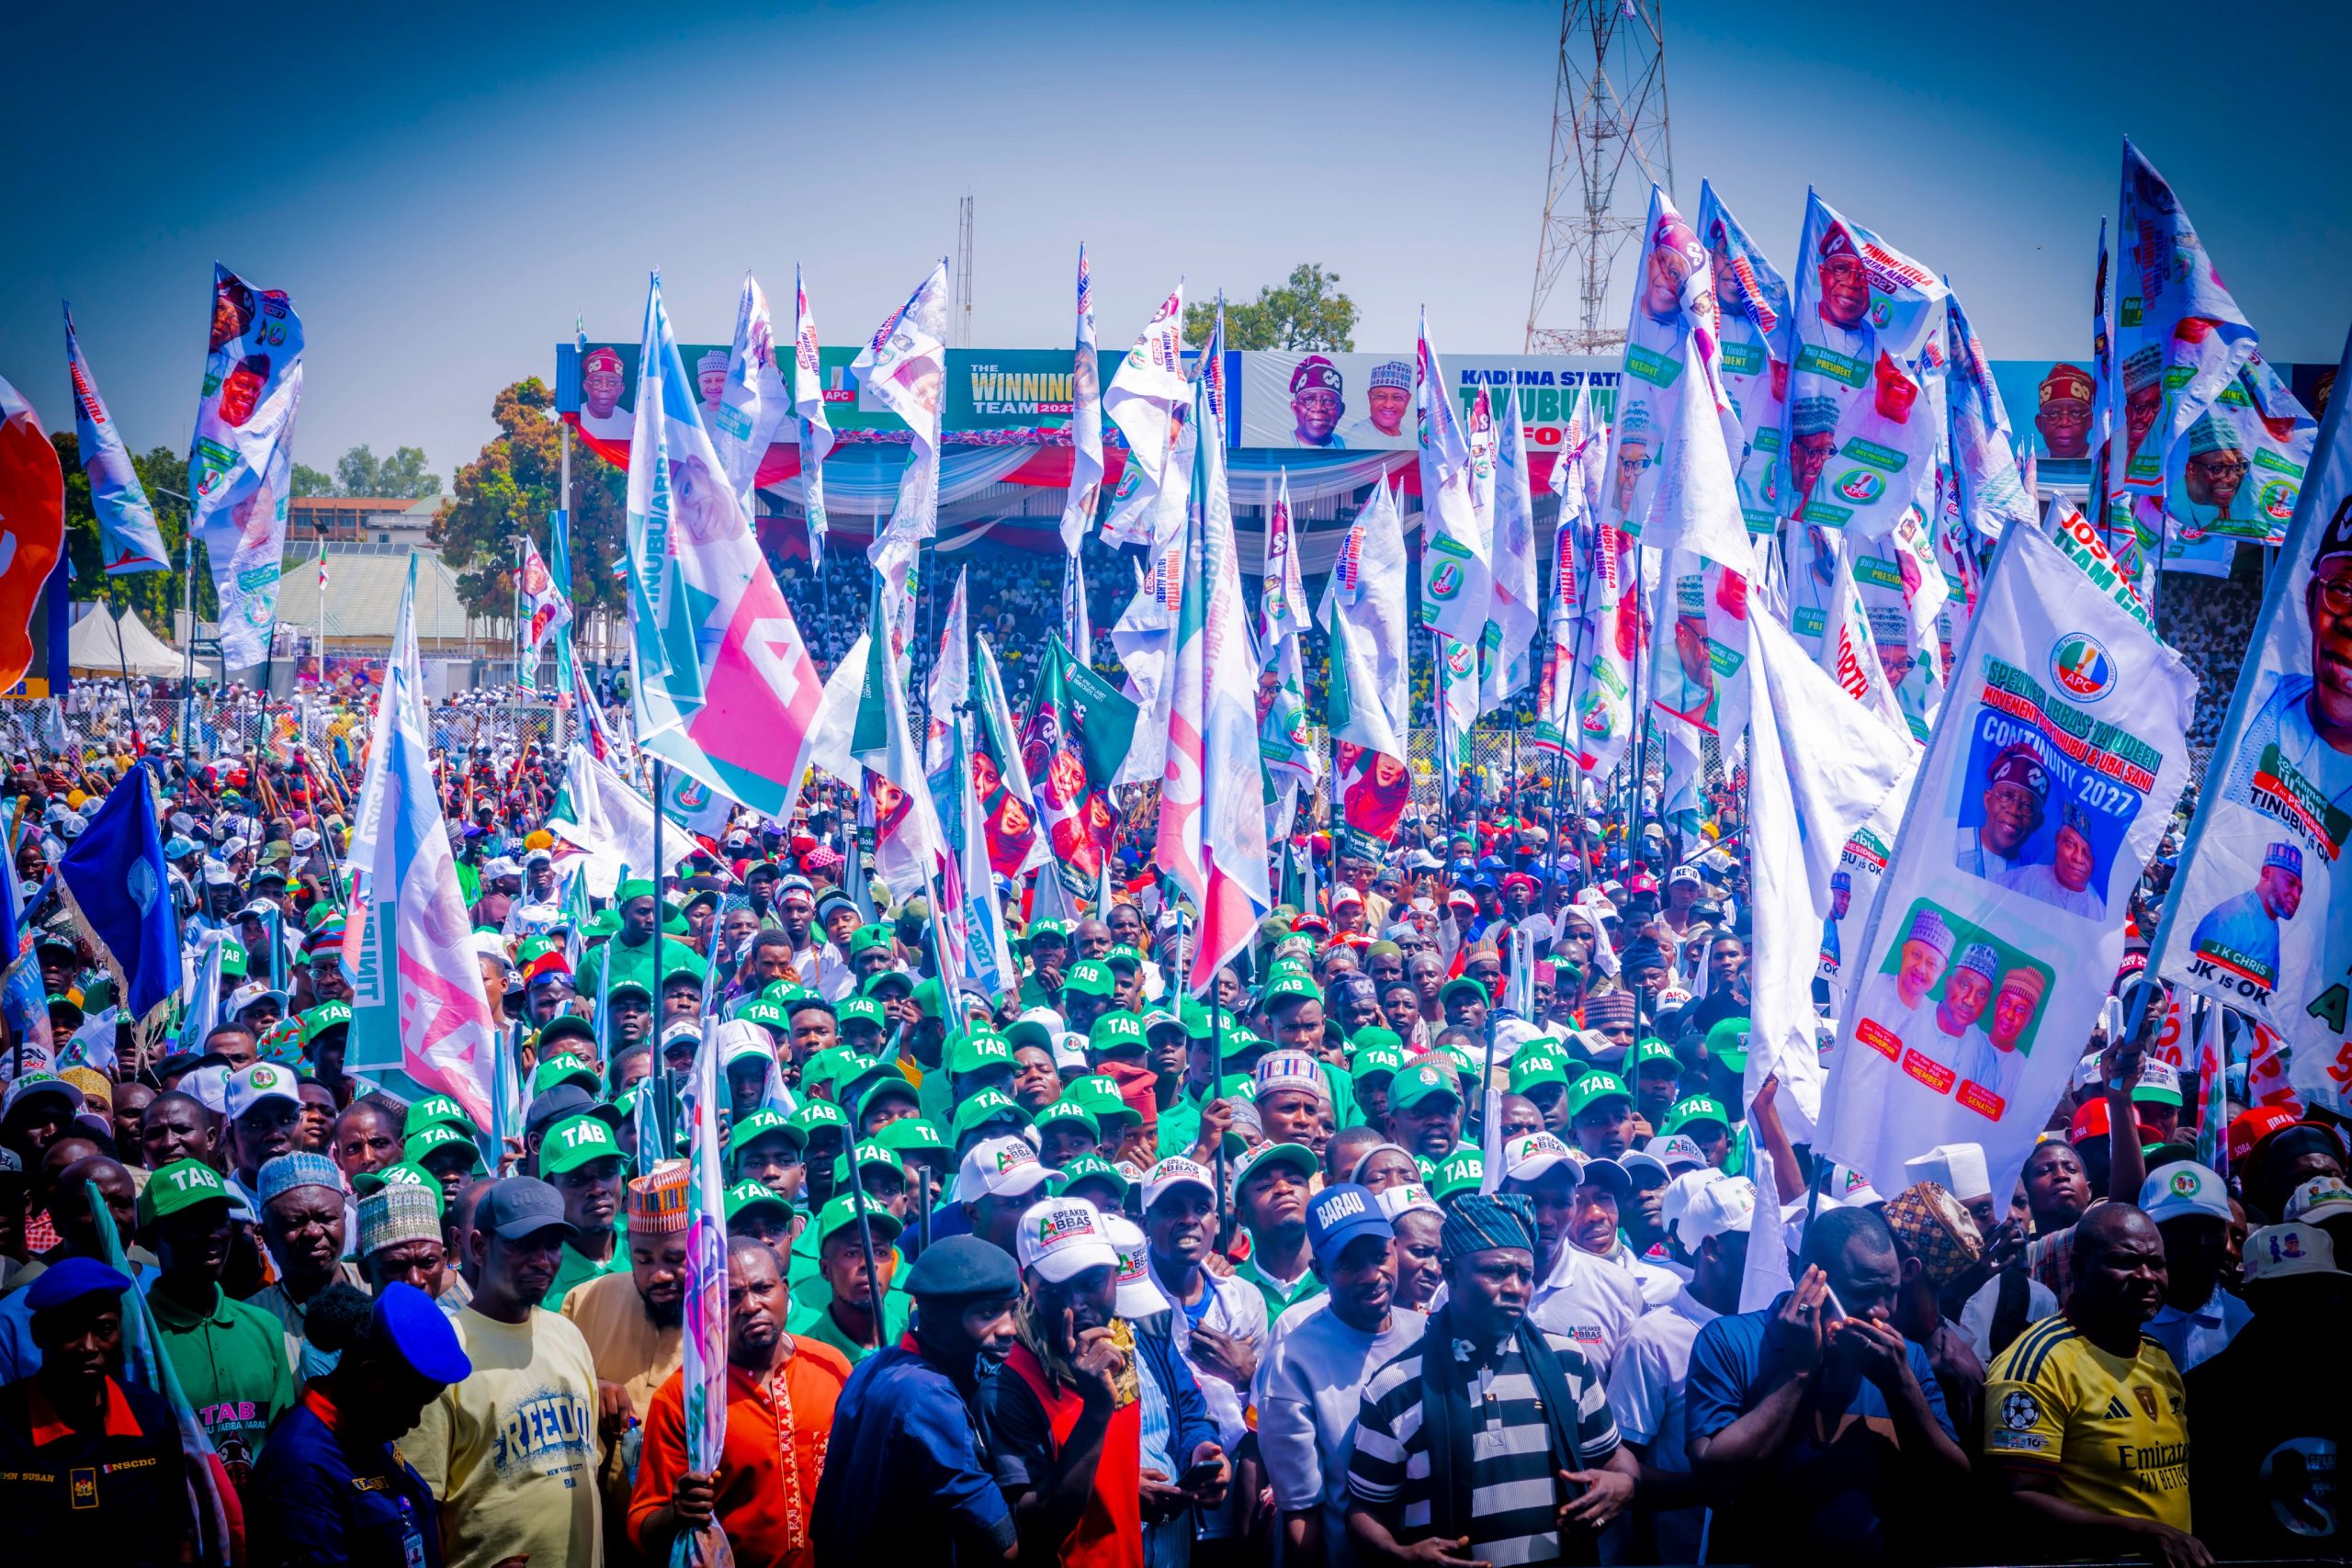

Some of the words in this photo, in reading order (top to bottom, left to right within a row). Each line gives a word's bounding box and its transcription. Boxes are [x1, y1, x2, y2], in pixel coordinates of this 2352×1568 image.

[1861, 243, 1901, 268] TINUBU
[1898, 265, 1934, 287] FITILA
[1861, 256, 1887, 273] FATAN
[1884, 269, 1916, 289] ALHERI
[1731, 256, 1761, 299] TINUBU
[1866, 271, 1895, 291] 2027
[264, 304, 285, 319] 2027
[797, 342, 808, 368] 2027
[1152, 338, 1163, 365] 2027
[1816, 359, 1851, 378] PRESIDENT
[825, 391, 849, 400] APC
[83, 393, 106, 425] FITILA
[973, 402, 1038, 413] TEAM
[1846, 488, 1864, 497] APC
[2270, 509, 2291, 517] APC
[1349, 526, 1364, 560] TINUBU
[2061, 512, 2108, 560] JOS
[1157, 558, 1166, 578] FATAN
[1168, 549, 1180, 581] TINUBU
[1860, 558, 1874, 569] Bola
[1876, 561, 1897, 574] Ahmed
[2053, 527, 2116, 592] TEAM
[1346, 561, 1360, 590] FITILA
[1605, 555, 1617, 589] FITILA
[1871, 570, 1902, 585] PRESID
[1157, 579, 1166, 603] ALHERI
[1168, 581, 1180, 612] FITILA
[1435, 583, 1449, 592] APC
[1563, 571, 1577, 604] FITILA
[2056, 642, 2066, 653] ALL
[2066, 635, 2102, 651] PROGRESSIVES
[2101, 649, 2114, 682] CONGRESS
[2065, 673, 2093, 693] APC
[1987, 660, 2047, 712] SPEAKER
[2046, 695, 2093, 739] ABBAS
[2089, 720, 2163, 775] TAJUDEEN
[1981, 686, 2039, 726] MOVEMENT
[2052, 728, 2089, 760] TINUBU
[2086, 748, 2098, 766] &
[2098, 752, 2122, 779] UBA
[2123, 766, 2155, 795] SANI
[1983, 716, 2077, 789] CONTINUITY
[2078, 775, 2134, 816] 2027
[682, 795, 696, 804] APC
[2295, 776, 2329, 807] Ahmed
[2250, 786, 2307, 838] TINUBU
[2288, 795, 2329, 846] PRESIDENT
[1868, 863, 1882, 876] OK
[1037, 920, 1058, 931] TAB
[968, 931, 993, 967] 2027
[1110, 946, 1132, 956] TAB
[1074, 966, 1100, 983] TAB
[1824, 963, 1838, 977] OK
[2233, 953, 2267, 976] CHRIS
[2187, 959, 2219, 980] JK
[2236, 980, 2271, 1007] OK
[849, 999, 874, 1013] TAB
[1666, 991, 1689, 1001] AKY
[320, 1006, 352, 1022] TAB
[749, 1005, 779, 1020] TAB
[1108, 1019, 1140, 1035] TAB
[973, 1039, 1007, 1057] TAB
[1643, 1042, 1671, 1057] TAB
[1868, 1033, 1895, 1055] GOVERNOR
[1367, 1052, 1397, 1066] TAB
[1520, 1057, 1554, 1075] TAB
[1913, 1066, 1944, 1089] MEMBER
[1931, 1064, 1949, 1077] Abbas
[1580, 1076, 1616, 1095] TAB
[424, 1101, 460, 1118] TAB
[800, 1105, 837, 1123] TAB
[1679, 1100, 1713, 1117] TAB
[1967, 1096, 1996, 1116] SENATOR
[561, 1121, 606, 1148] TAB
[2075, 1126, 2086, 1139] SOBA
[855, 1145, 892, 1164] TAB
[2234, 1143, 2251, 1156] SOBA
[1153, 1164, 1199, 1182] ABBAS
[1167, 1160, 1198, 1170] SPEAKER
[1443, 1158, 1484, 1181] TAB
[171, 1171, 217, 1193] TAB
[1054, 1209, 1088, 1221] SPEAKER
[1317, 1192, 1365, 1230] BARAU
[1040, 1217, 1091, 1241] ABBAS
[1567, 1326, 1602, 1339] ABBAS
[199, 1402, 255, 1426] TAB
[490, 1397, 594, 1470] FREEDO
[112, 1458, 156, 1471] NSCDC
[2117, 1440, 2188, 1470] Emirate
[22, 1472, 55, 1483] SUSAN
[560, 1465, 572, 1474] YORK
[572, 1463, 583, 1472] CITY
[2138, 1472, 2157, 1493] FLY
[2162, 1466, 2188, 1492] BETTE
